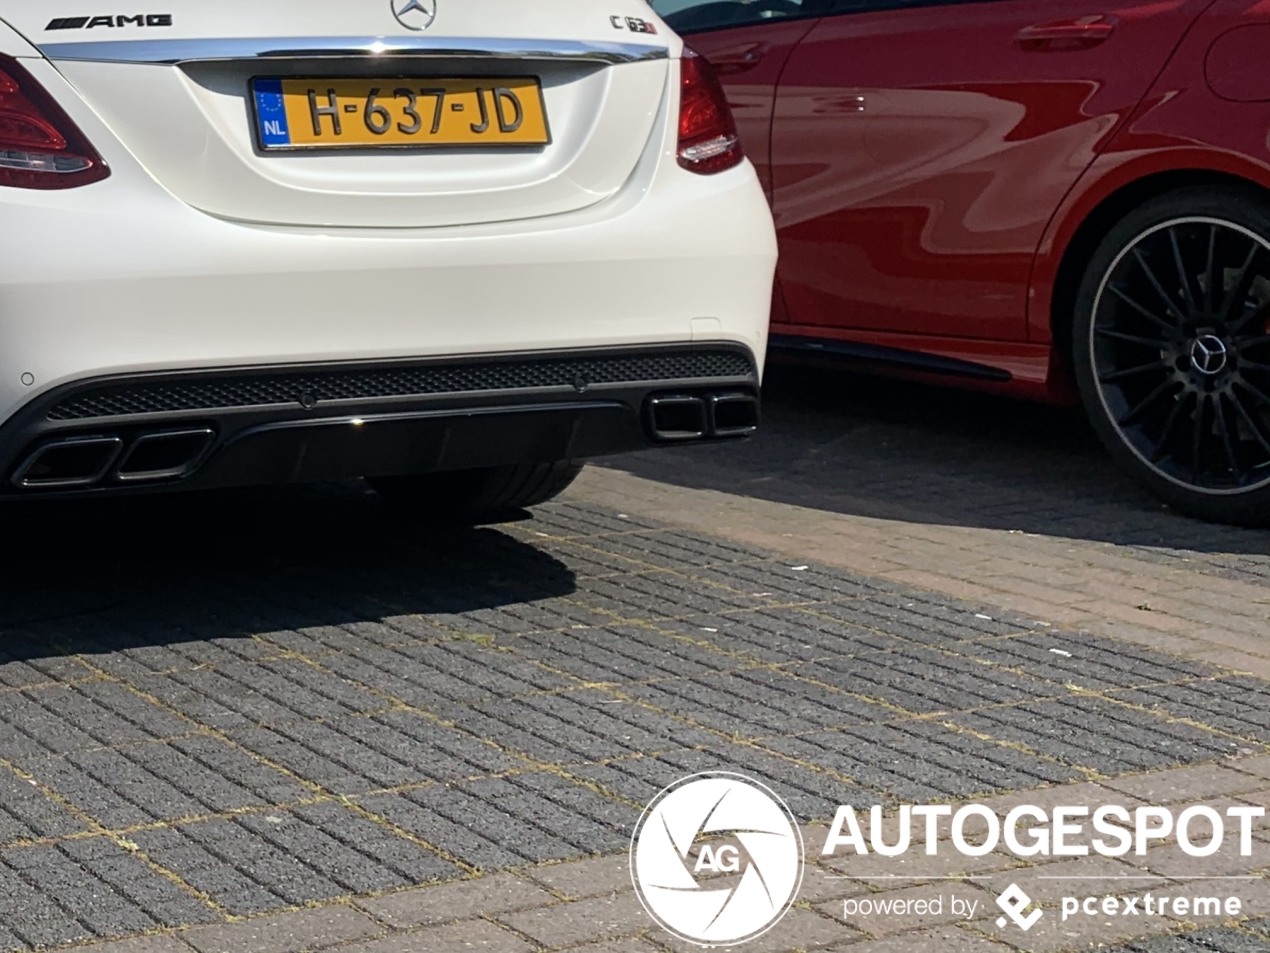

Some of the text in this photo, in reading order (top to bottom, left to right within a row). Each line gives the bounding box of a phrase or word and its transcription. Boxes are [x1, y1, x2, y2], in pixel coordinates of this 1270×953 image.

[84, 14, 172, 29] AMG
[264, 87, 523, 136] NL H-637-JD
